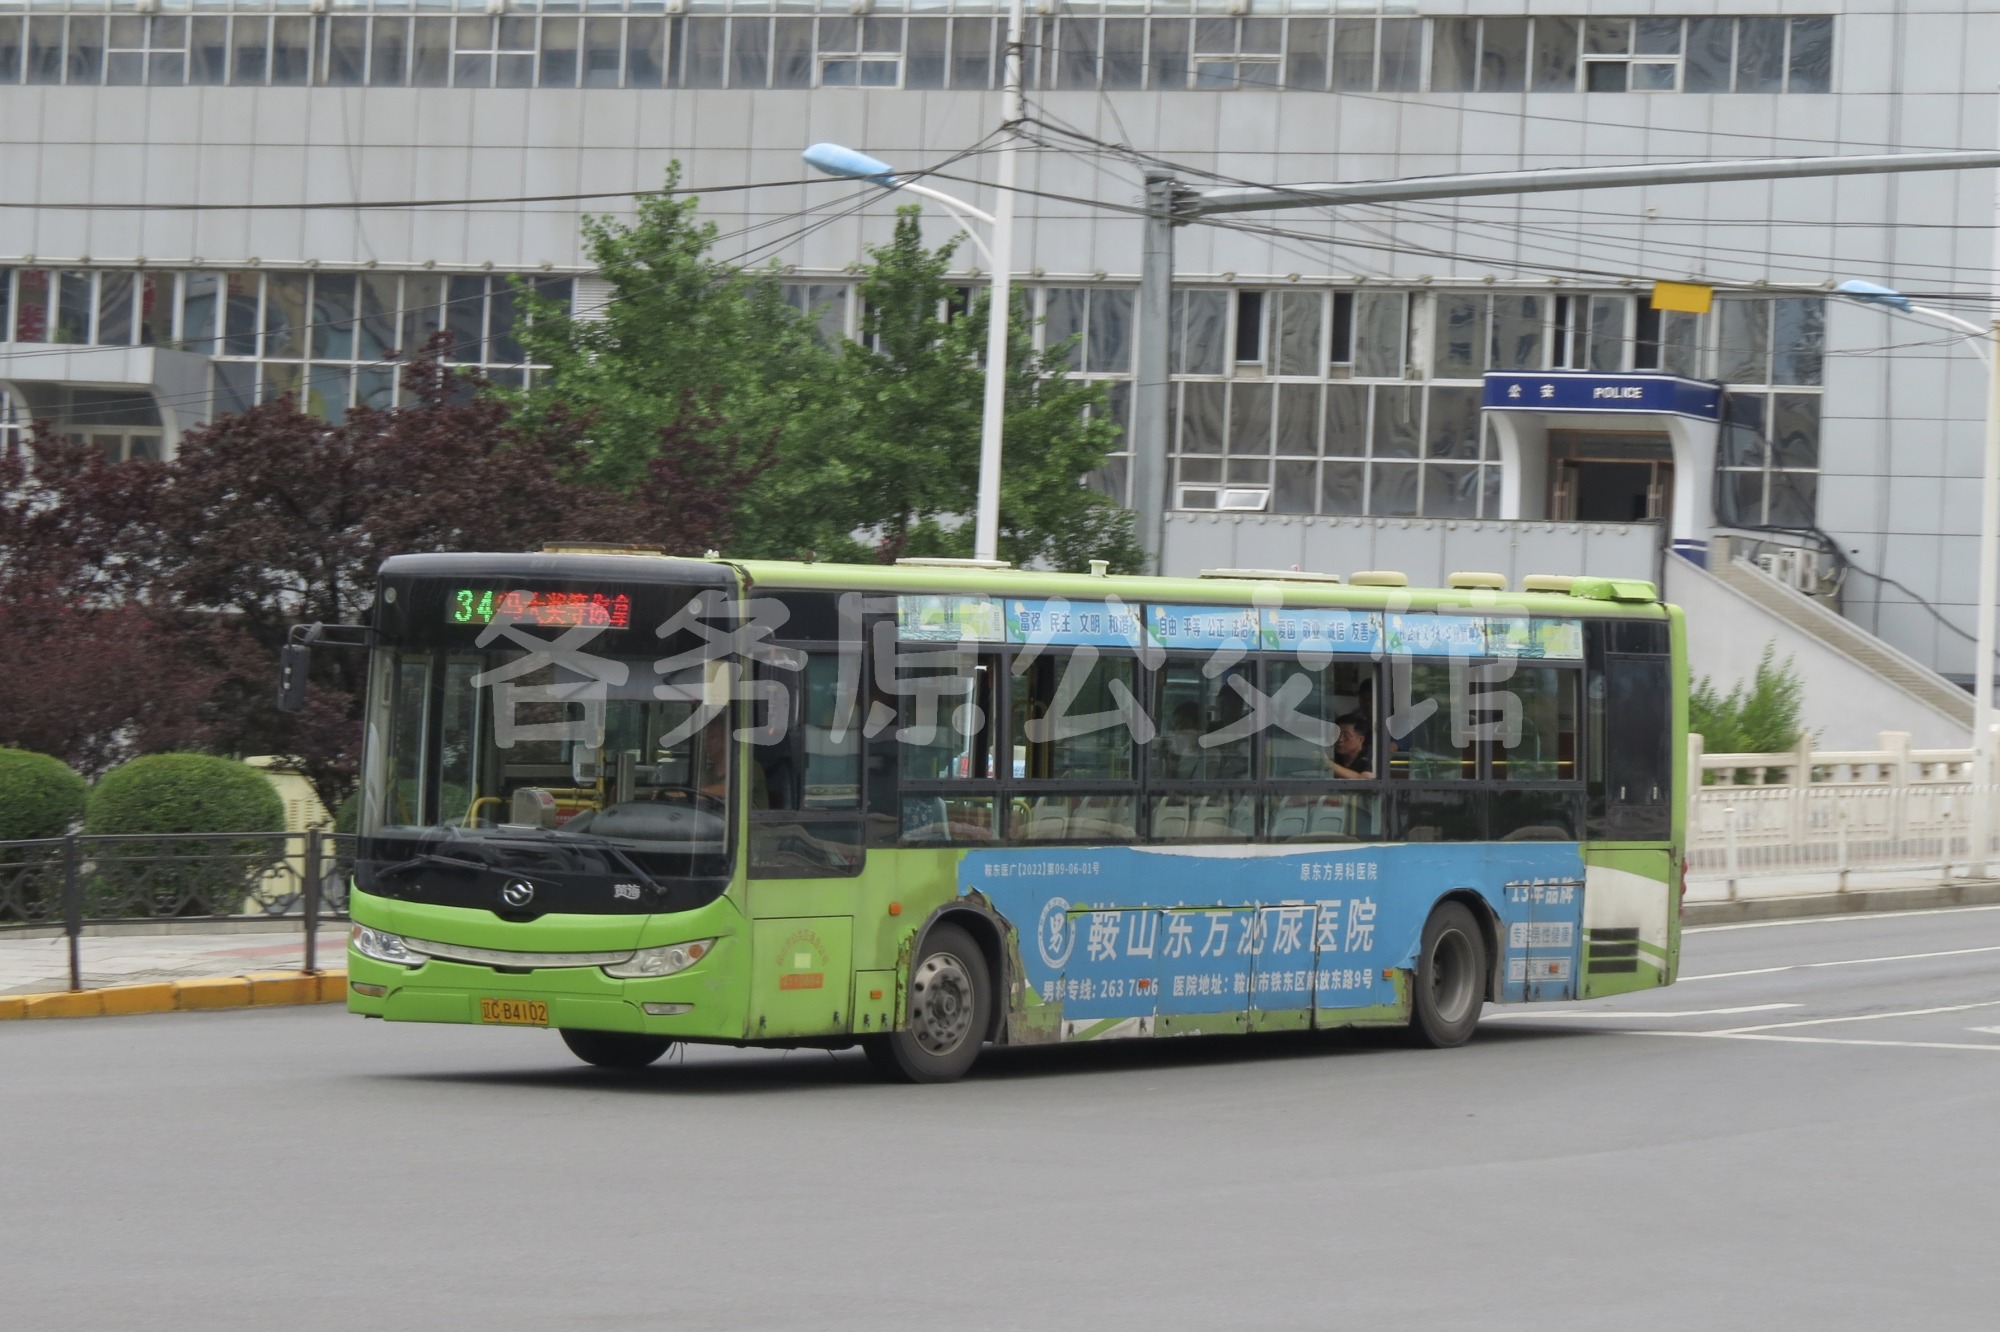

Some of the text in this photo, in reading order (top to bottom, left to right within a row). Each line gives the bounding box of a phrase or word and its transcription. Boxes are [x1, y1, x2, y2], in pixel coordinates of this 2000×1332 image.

[1593, 387, 1643, 399] POLICE
[454, 589, 494, 623] 34
[1019, 611, 1042, 634] 富强
[1050, 612, 1071, 635] 民主
[1079, 613, 1101, 635] 文明
[1108, 613, 1131, 636] 和谐
[1158, 616, 1249, 638] 自由 平等 公正 法治
[1277, 619, 1369, 643] 爱国 敬业 诚信 友善
[1300, 861, 1378, 881] 原东方男科医院
[613, 884, 641, 900] 黄海
[1511, 877, 1575, 905] 13年品牌
[1087, 897, 1377, 962] 鞍山东方泌尿医院
[1100, 979, 1124, 998] 263
